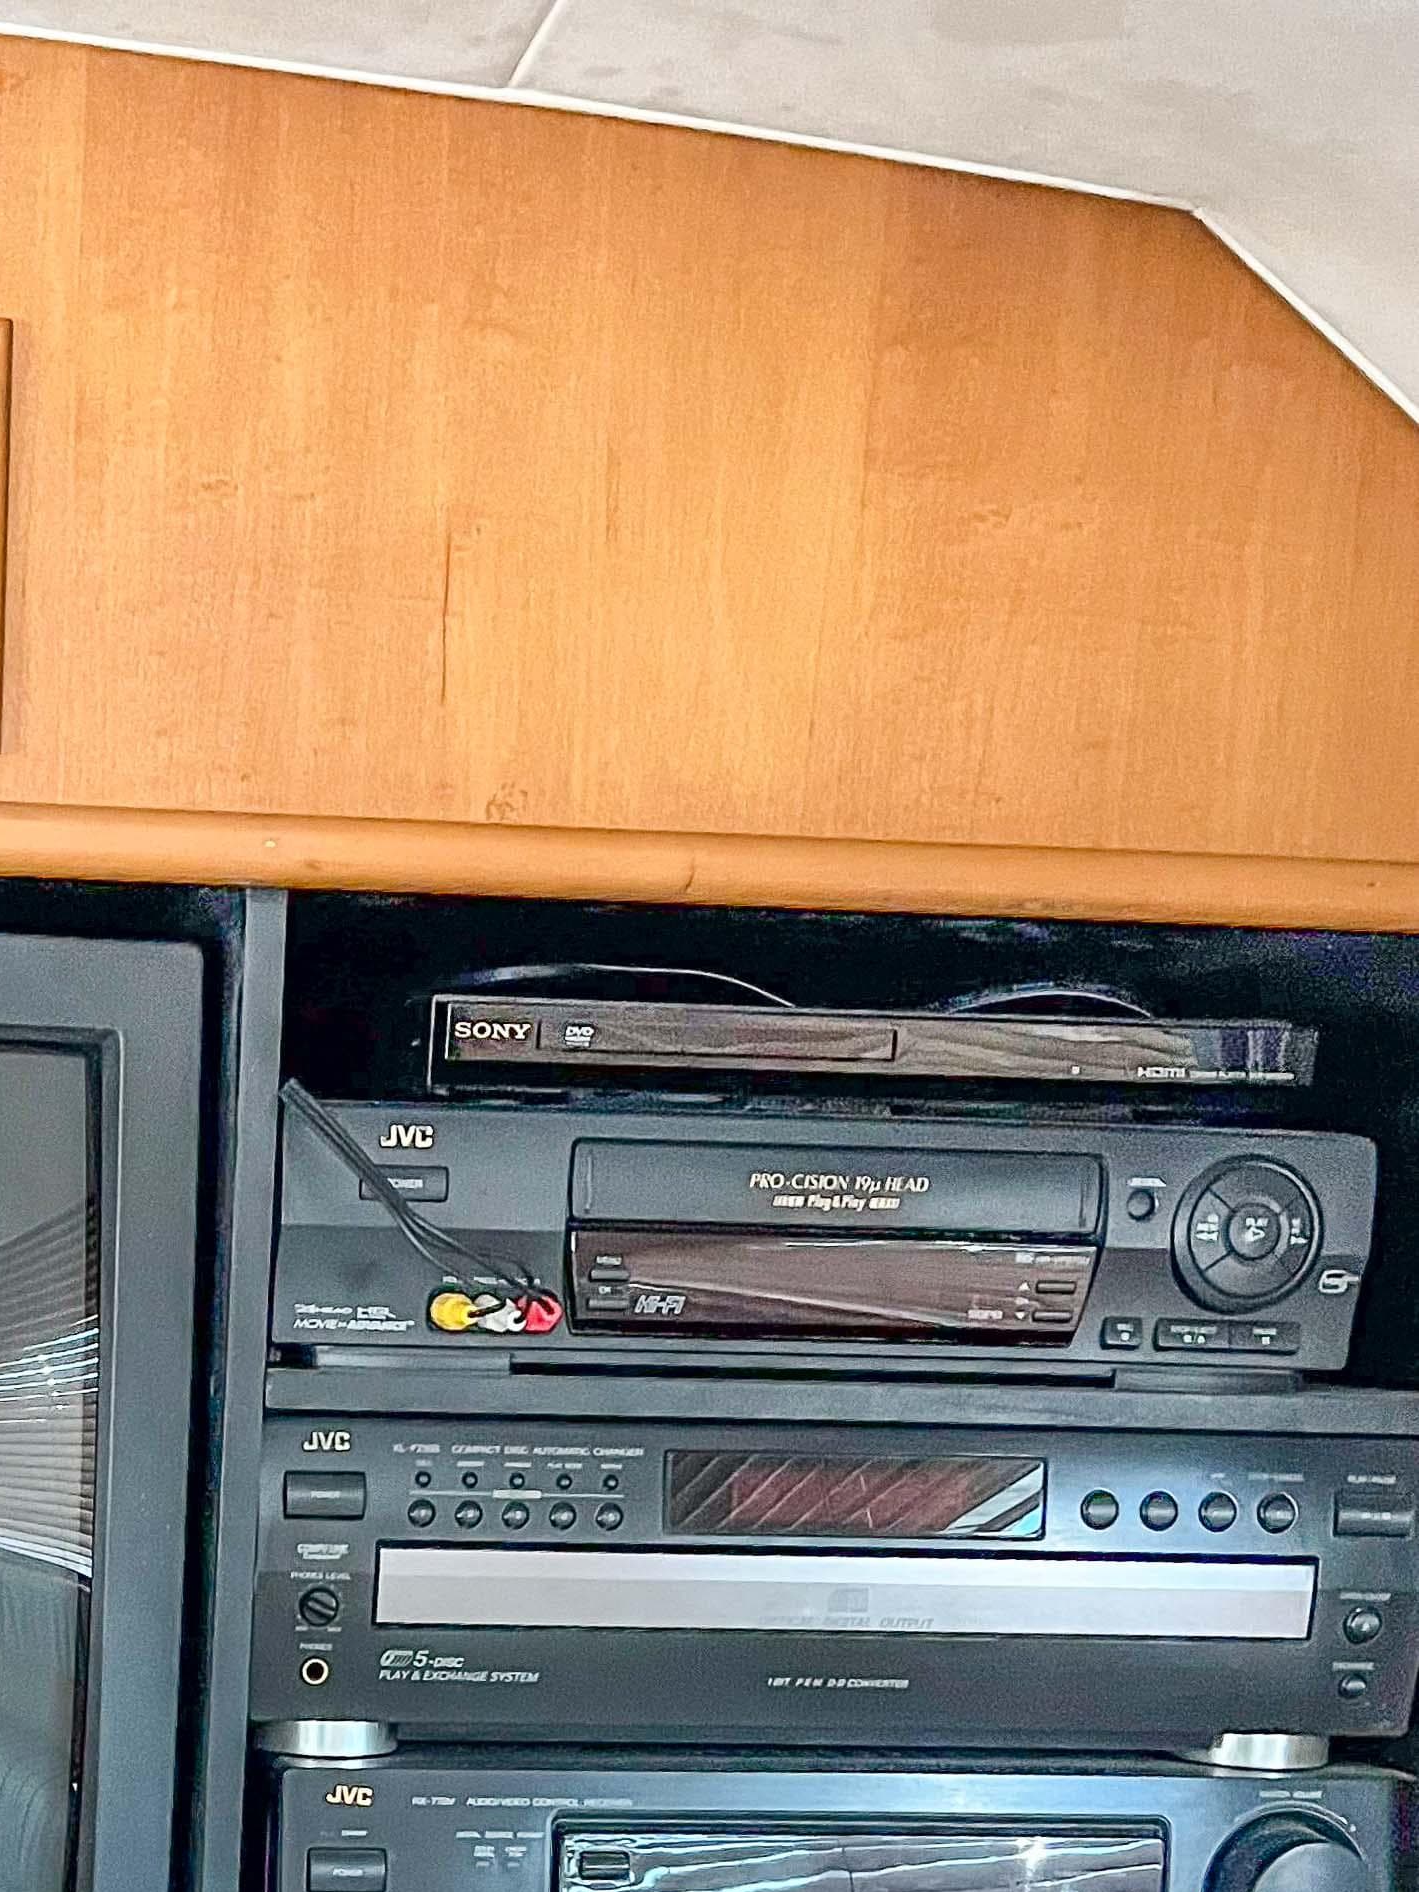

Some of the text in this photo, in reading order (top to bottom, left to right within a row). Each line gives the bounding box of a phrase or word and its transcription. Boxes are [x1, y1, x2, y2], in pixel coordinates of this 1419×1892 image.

[454, 1021, 532, 1040] SONY
[565, 1024, 595, 1037] DVD
[379, 1123, 434, 1149] JVC
[885, 1177, 930, 1193] HEAD
[303, 1431, 351, 1451] JVC
[325, 1785, 373, 1806] JVC
